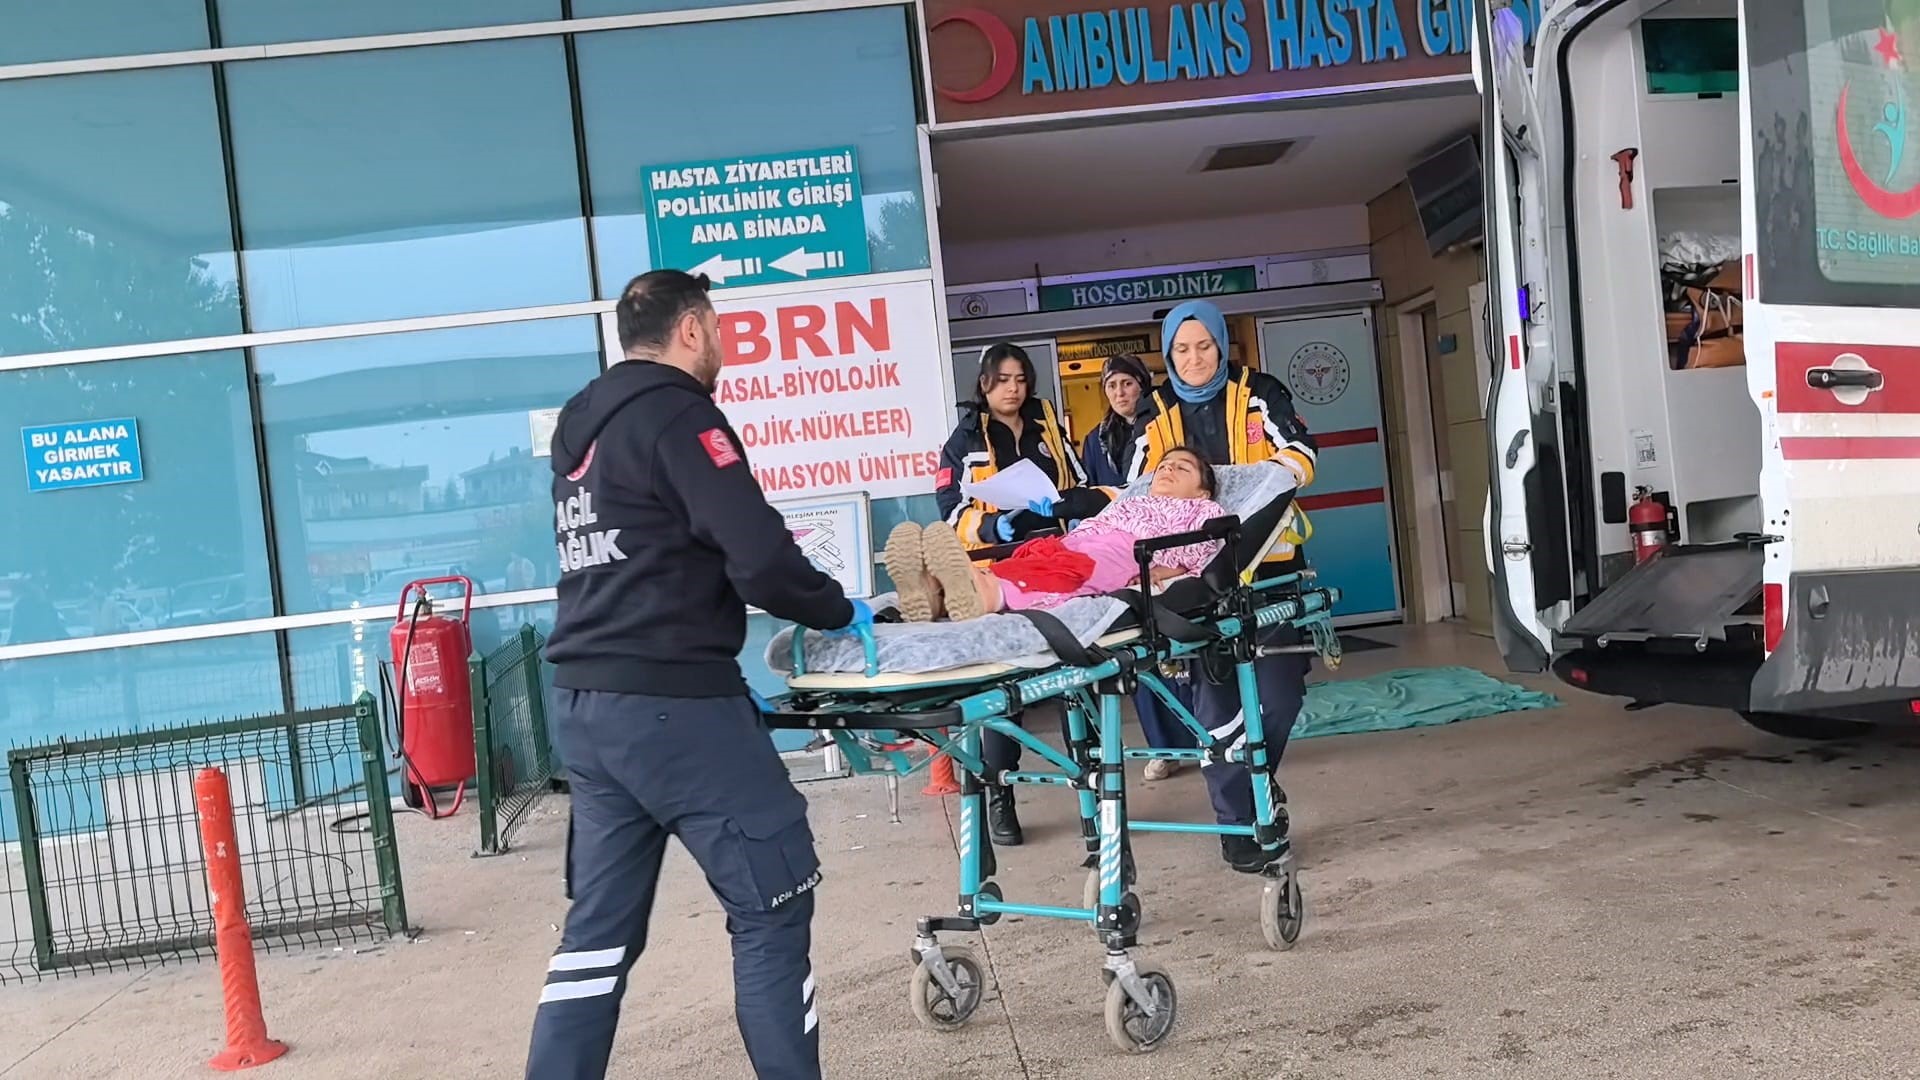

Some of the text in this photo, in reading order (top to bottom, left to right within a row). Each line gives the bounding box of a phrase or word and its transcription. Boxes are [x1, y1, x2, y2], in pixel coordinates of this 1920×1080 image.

[1022, 1, 1252, 95] AMBULANS
[1264, 0, 1407, 71] HASTA
[651, 150, 853, 190] HASTA ZİYARETLERİ
[658, 177, 853, 218] POLİKLİNİK GİRİŞİ
[691, 213, 827, 244] ANA BİNADA
[1846, 230, 1895, 258] Sağlık
[1900, 235, 1920, 256] Ba
[1072, 272, 1224, 307] HOŞGELDİNİZ
[718, 297, 892, 367] BRN
[711, 358, 901, 404] ASAL-BİYOLOJİK
[31, 425, 128, 448] BU ALANA
[742, 407, 912, 449] OJİK-NÜKLEER)
[36, 461, 133, 484] YASAKTIR
[44, 444, 120, 465] GİRMEK
[753, 458, 852, 492] İNASYON
[857, 443, 942, 483] ÜNİTES
[557, 529, 628, 572] AĞLIK
